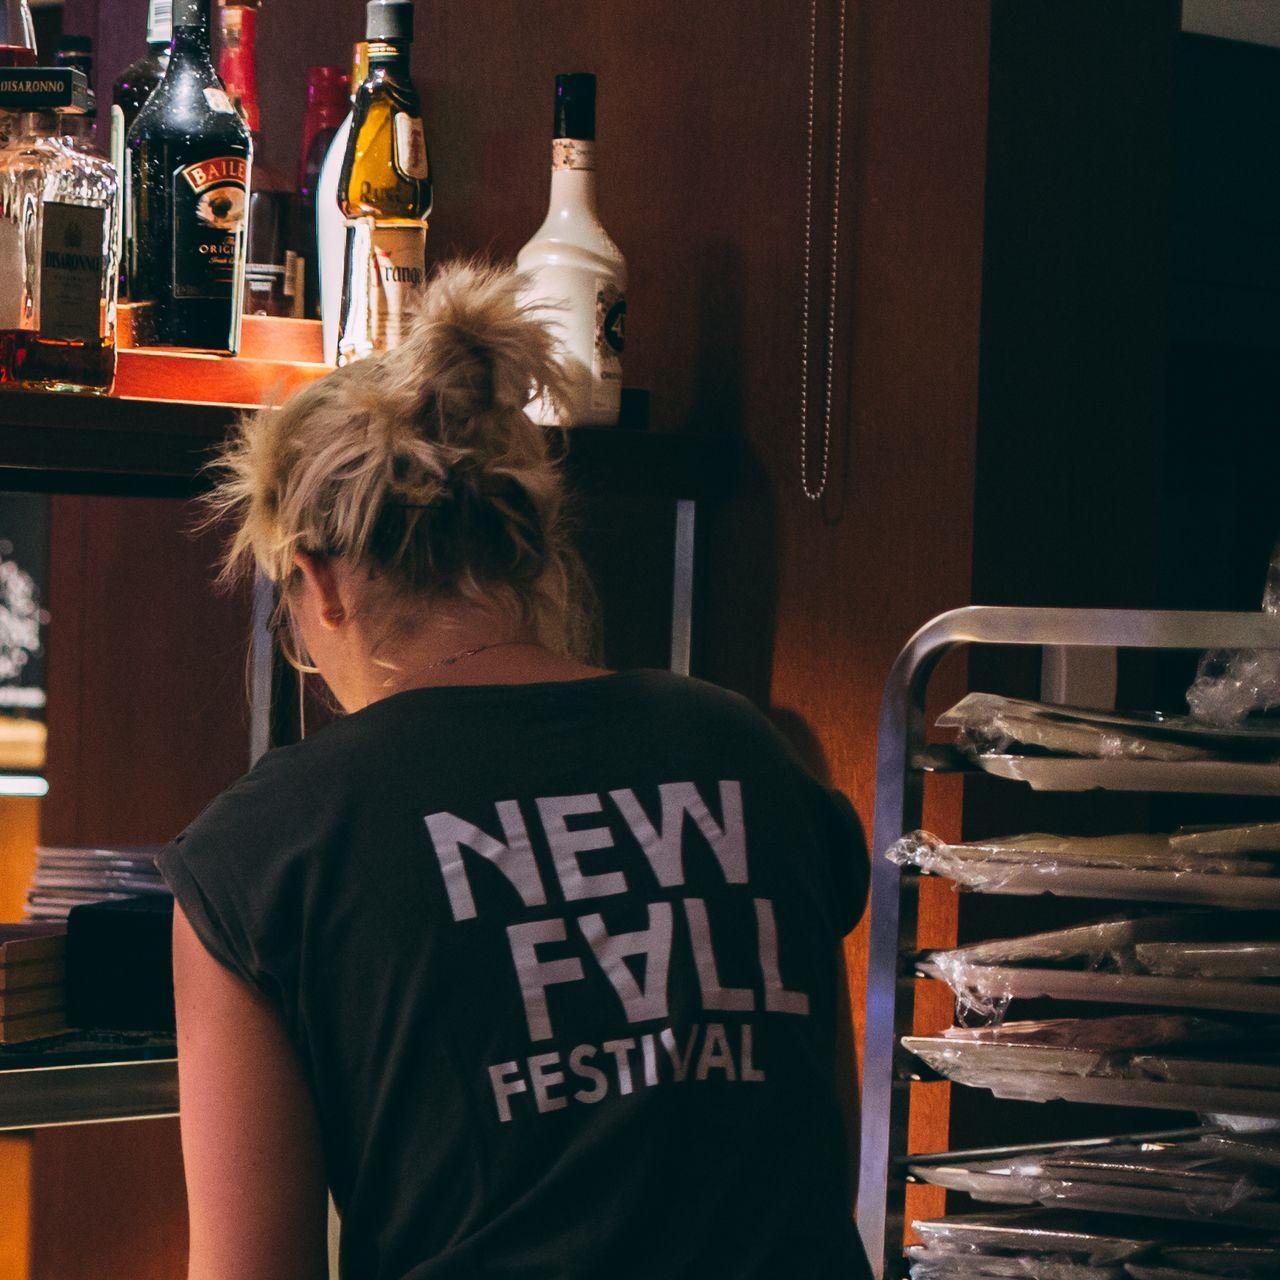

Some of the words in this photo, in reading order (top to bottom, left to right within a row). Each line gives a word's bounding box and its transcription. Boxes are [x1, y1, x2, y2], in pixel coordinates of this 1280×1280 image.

[0, 80, 65, 93] DISARONNO
[424, 780, 749, 921] NEW
[506, 897, 811, 1042] FALL
[488, 1023, 766, 1122] FESTIVAL
